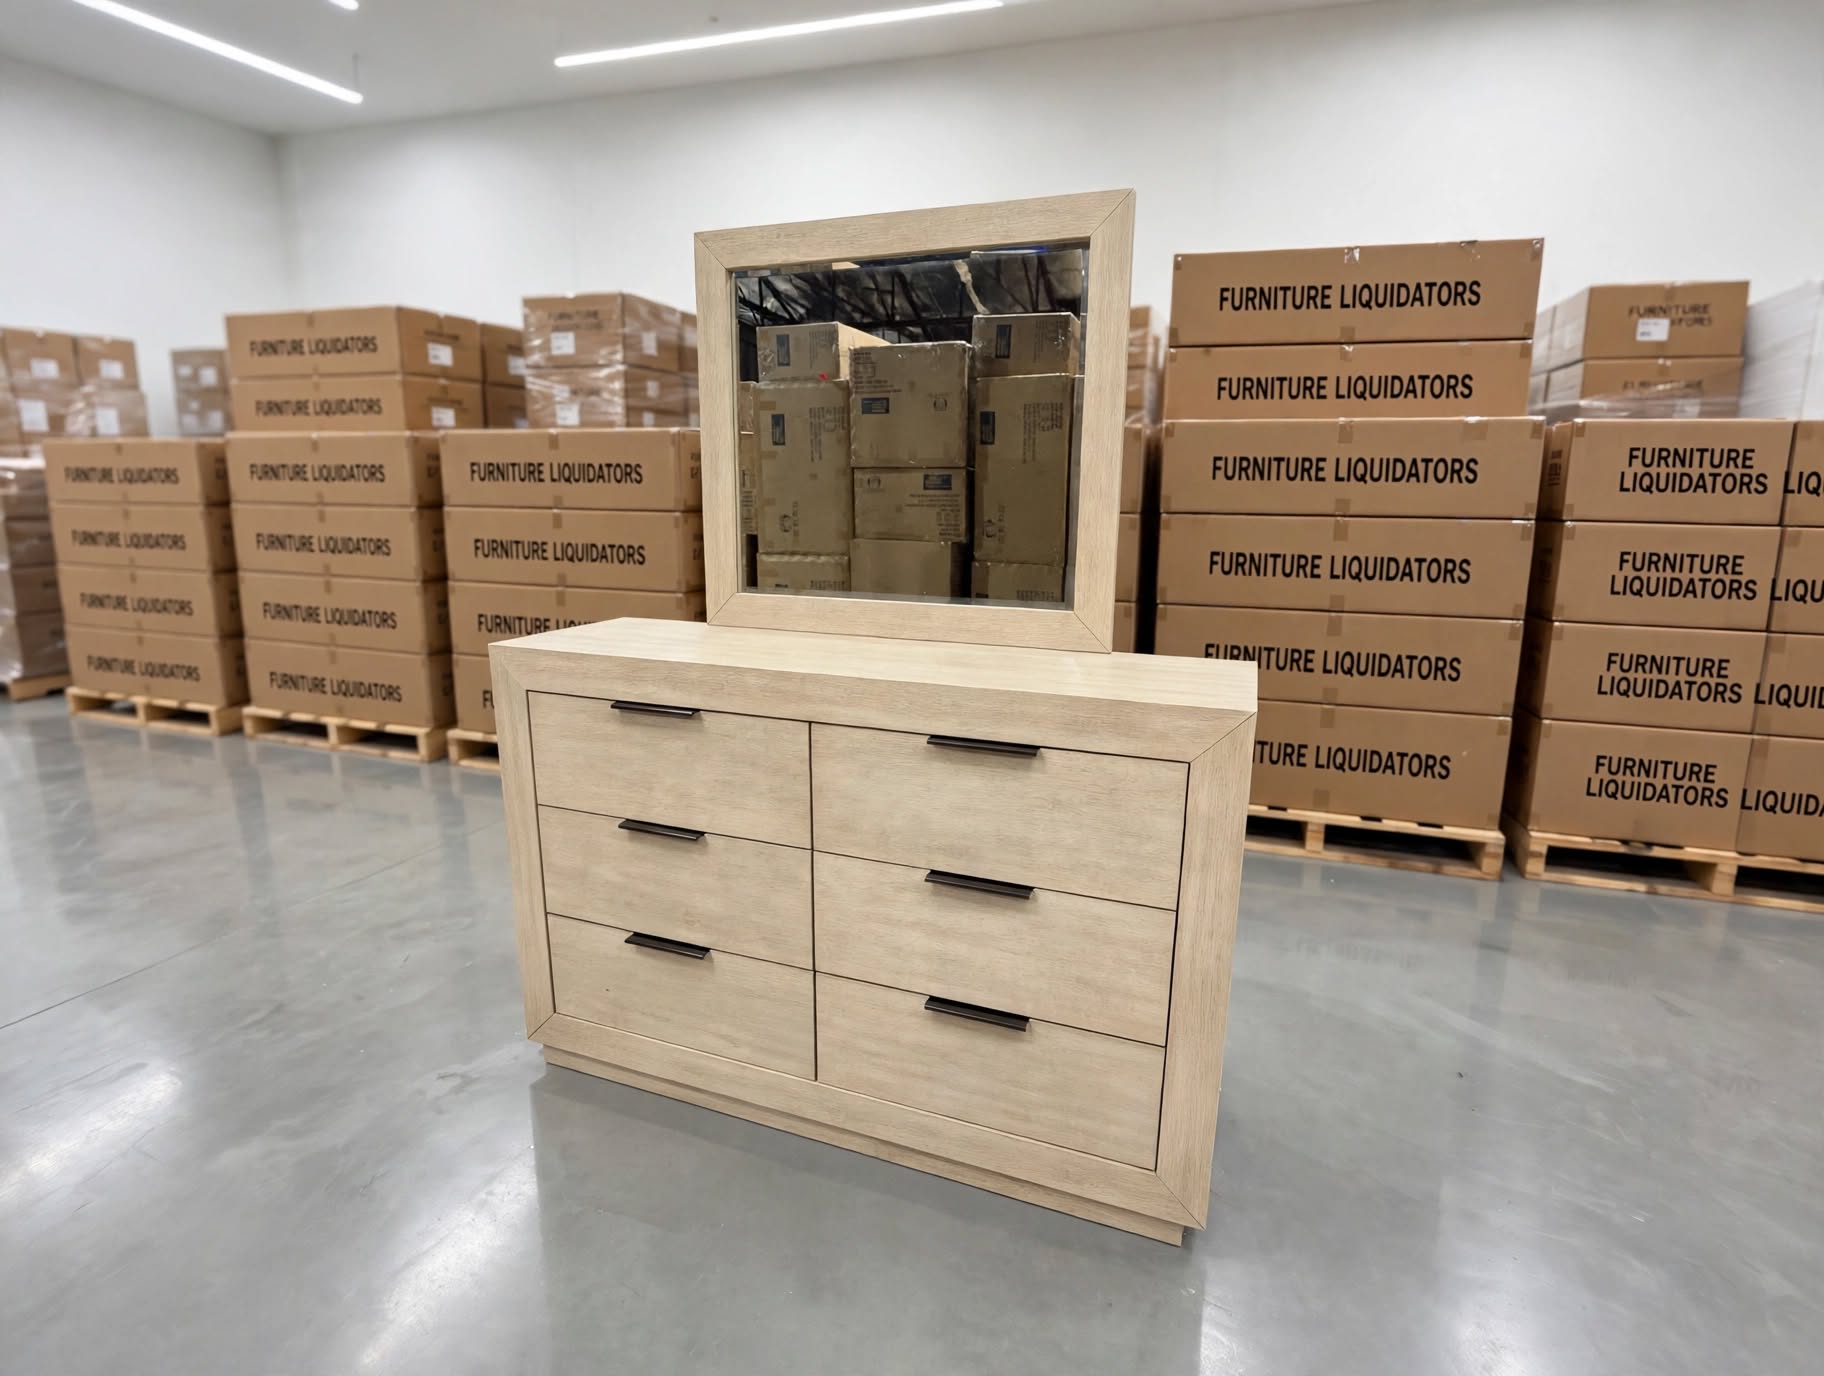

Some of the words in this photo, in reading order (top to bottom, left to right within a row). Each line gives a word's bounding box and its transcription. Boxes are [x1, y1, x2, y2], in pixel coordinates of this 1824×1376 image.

[1220, 285, 1332, 311] FURNITURE
[1340, 280, 1480, 310] LIQUIDATORS
[250, 339, 305, 356] FURNITURE
[309, 336, 378, 355] LIQUIDATORS
[1217, 376, 1328, 400] FURNITURE
[1336, 374, 1473, 400] LIQUIDATORS
[256, 399, 309, 417] FURNITURE
[311, 398, 382, 417] LIQUIDATORS
[1212, 456, 1327, 482] FURNITURE
[1335, 457, 1478, 484] LIQUIDATORS
[1629, 447, 1755, 469] FURNITURE
[250, 463, 309, 483] FURNITURE
[312, 464, 385, 483] LIQUIDATORS
[470, 462, 545, 482] FURNITURE
[550, 463, 643, 484] LIQUIDATORS
[1619, 471, 1768, 494] LIQUIDATORS
[1783, 471, 1824, 497] LIQ
[256, 533, 315, 553] FURNITURE
[318, 536, 391, 556] LIQUIDATORS
[474, 539, 548, 560] FURNITURE
[553, 542, 645, 565] LIQUIDATORS
[1209, 551, 1322, 579] FURNITURE
[1330, 555, 1471, 584] LIQUIDATORS
[1618, 551, 1744, 575] FURNITURE
[1610, 574, 1757, 601] LIQUIDATORS
[263, 602, 321, 624] FURNITURE
[325, 608, 397, 629] LIQUIDATORS
[478, 614, 550, 635] FURNITURE
[1323, 650, 1461, 682] LIQUIDATORS
[1606, 653, 1730, 678] FURNITURE
[269, 672, 327, 694] FURNITURE
[331, 680, 402, 703] LIQUIDATORS
[1597, 675, 1742, 704] LIQUIDATORS
[1315, 745, 1451, 780] LIQUIDATORS
[1595, 755, 1717, 783] FURNITURE
[1586, 777, 1728, 808] LIQUIDATORS
